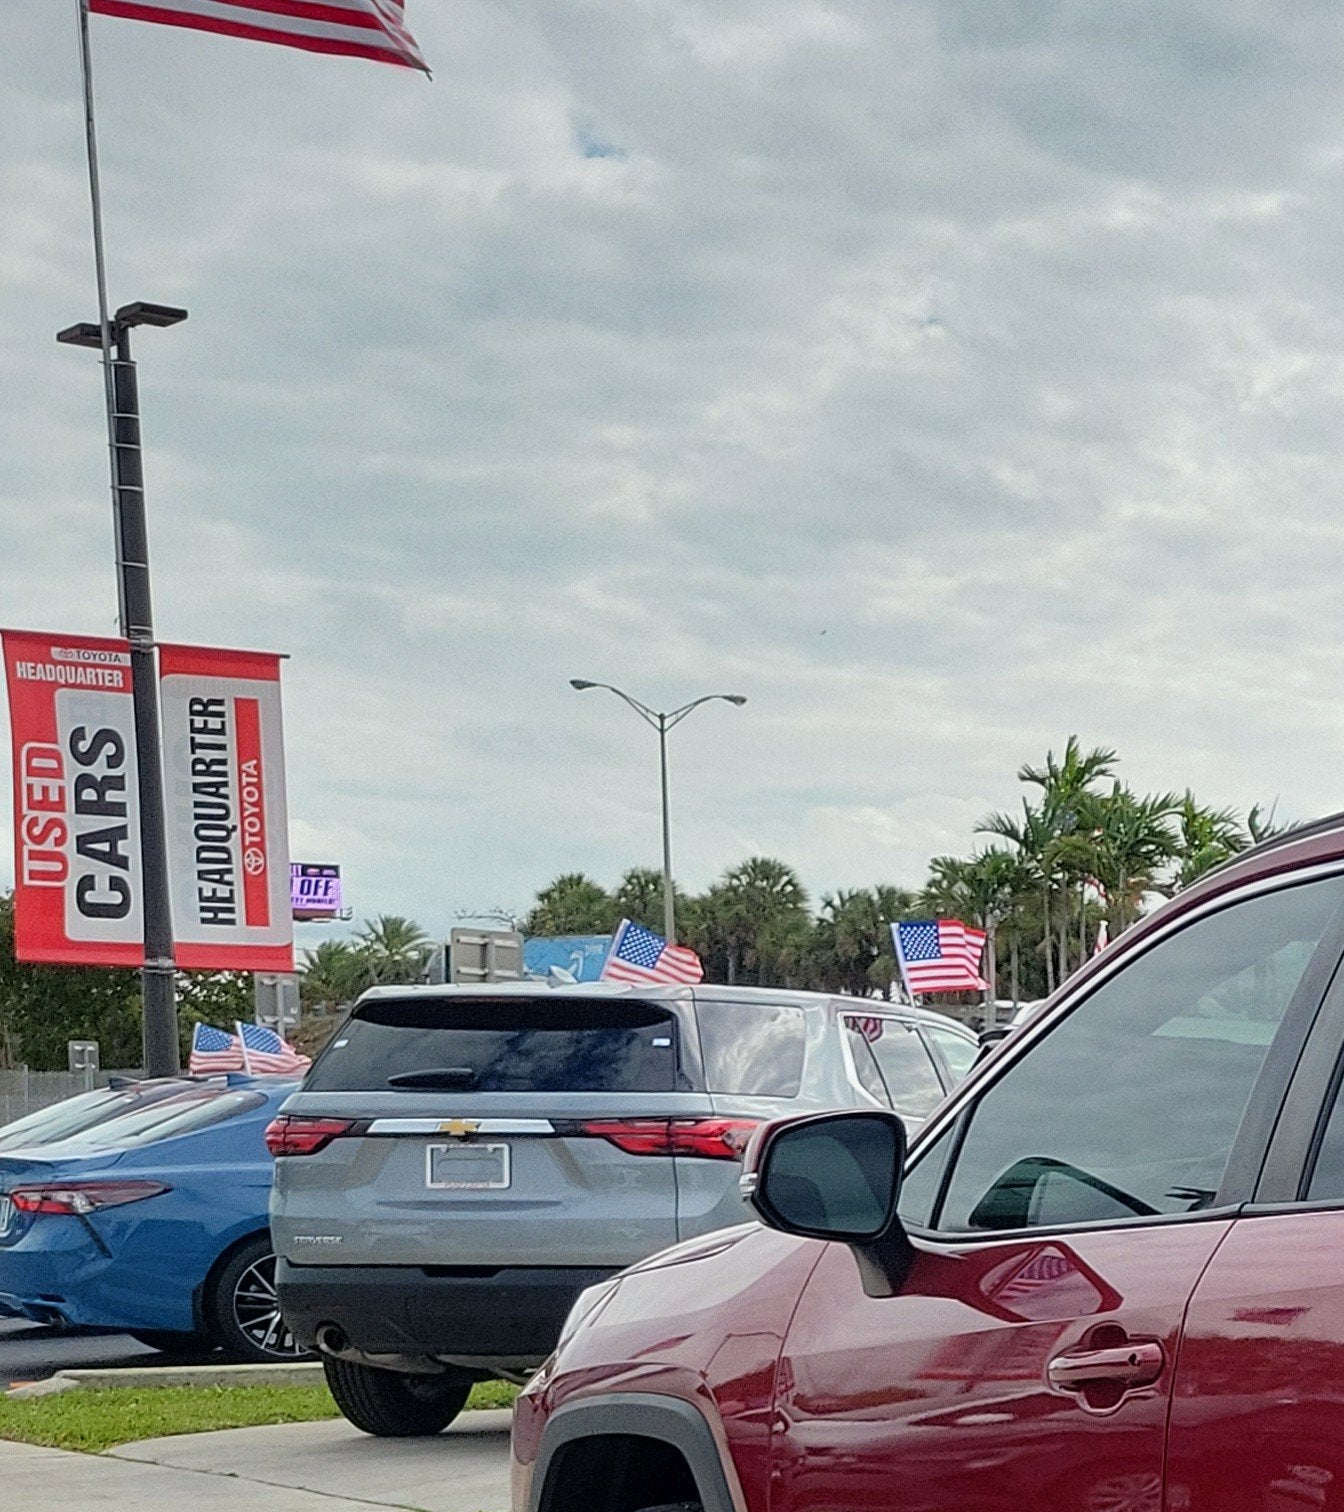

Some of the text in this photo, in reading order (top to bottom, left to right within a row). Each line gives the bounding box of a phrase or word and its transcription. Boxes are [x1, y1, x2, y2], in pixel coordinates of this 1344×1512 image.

[16, 661, 124, 688] HEADQUARTER
[75, 649, 122, 664] TOYOTA
[22, 742, 69, 886] USED
[69, 726, 132, 919] CARS
[189, 697, 237, 926] HEADQUARTER
[241, 759, 259, 842] TOYOTA
[299, 879, 334, 897] OFF
